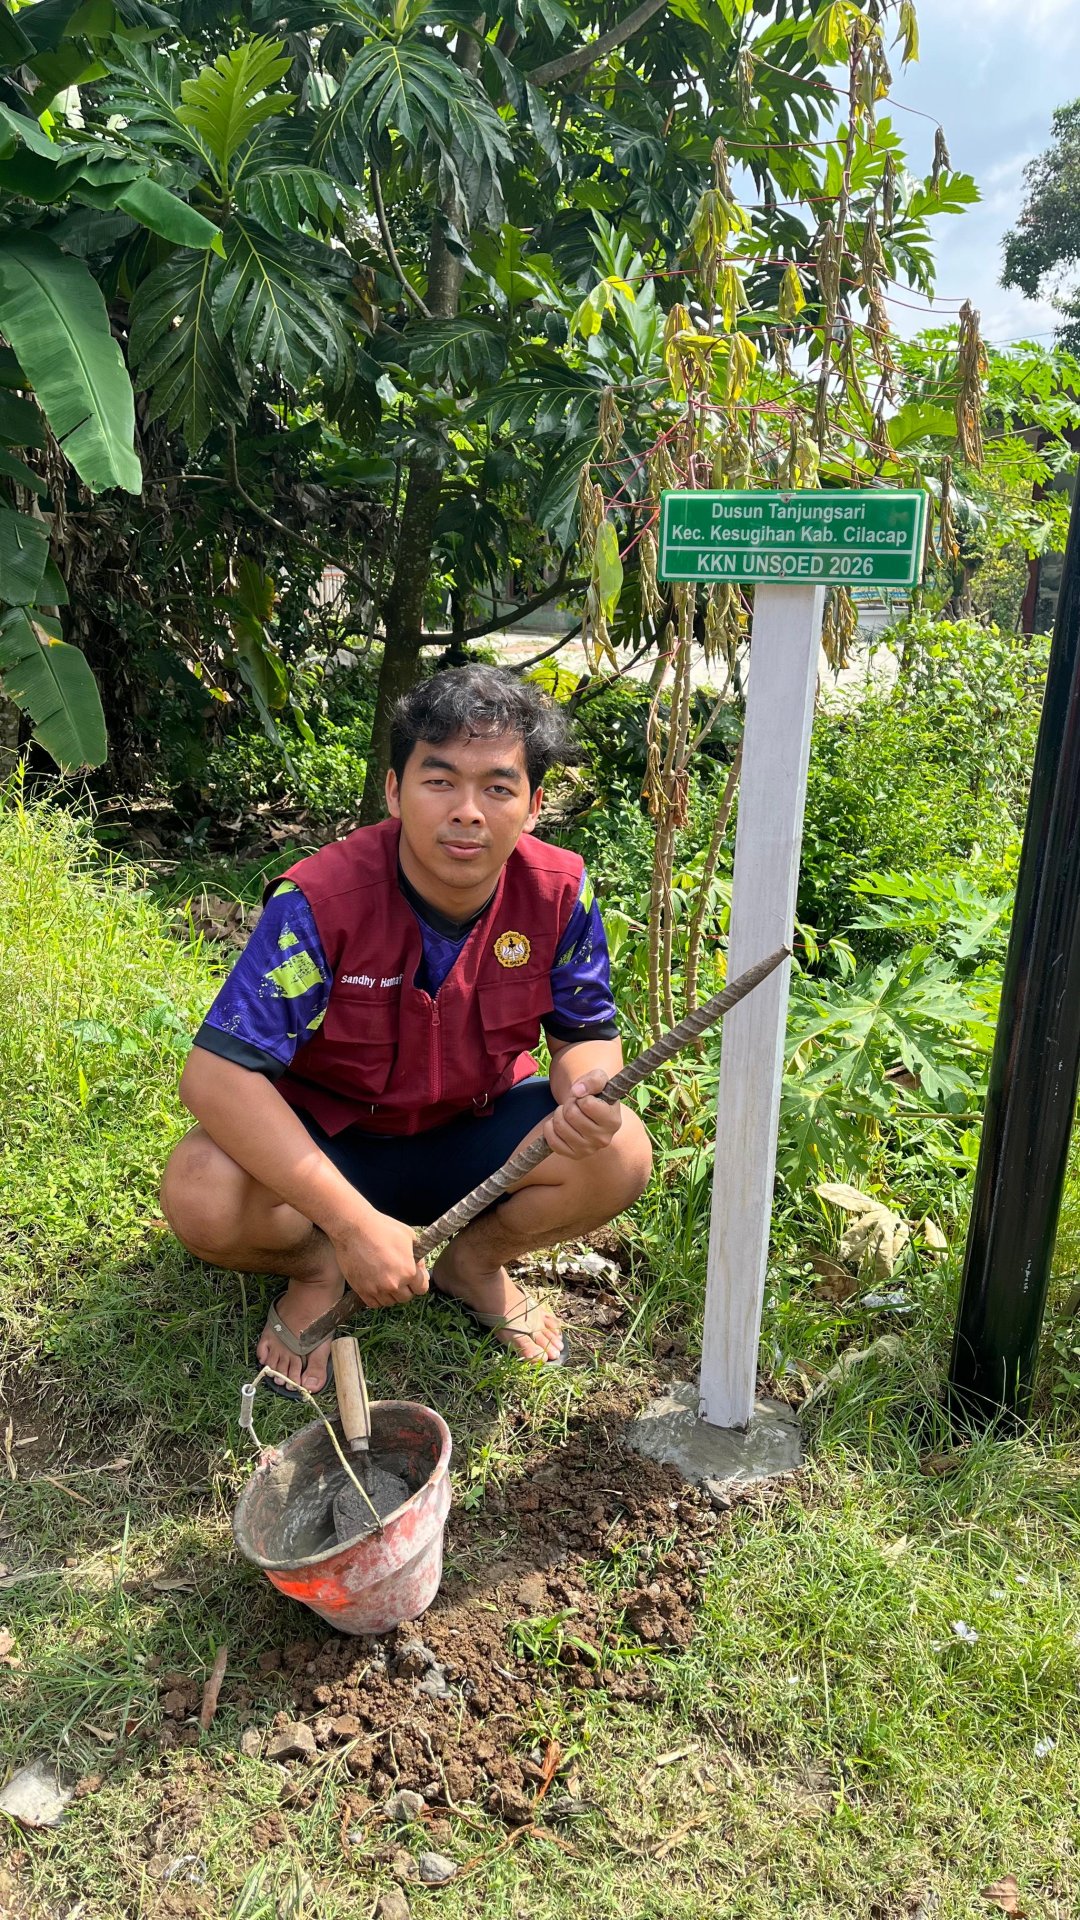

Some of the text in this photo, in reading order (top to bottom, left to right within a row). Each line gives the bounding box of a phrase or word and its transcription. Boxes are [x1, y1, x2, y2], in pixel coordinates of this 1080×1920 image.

[712, 503, 866, 523] Dusun Tanjungsari
[672, 525, 907, 546] Kec. Kesugihan Kab. Cilacap
[697, 554, 874, 576] KKN UNSOED 2026
